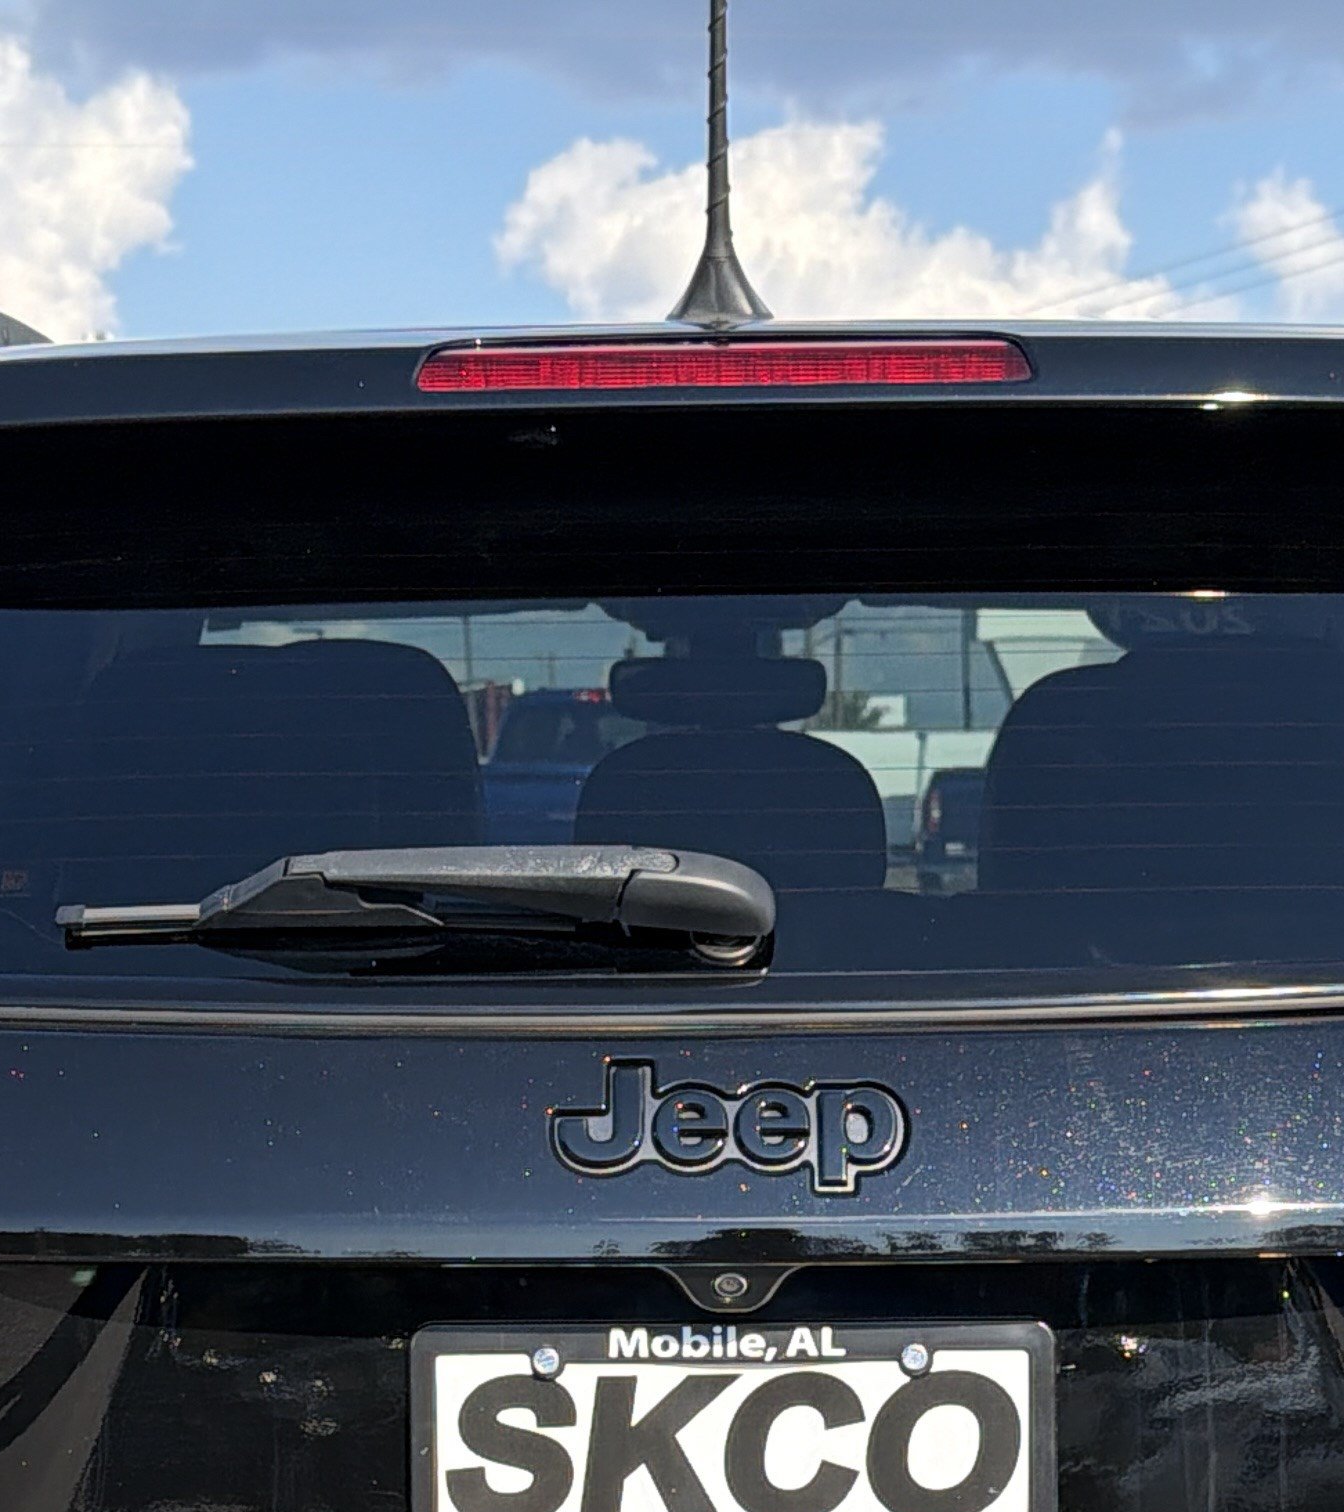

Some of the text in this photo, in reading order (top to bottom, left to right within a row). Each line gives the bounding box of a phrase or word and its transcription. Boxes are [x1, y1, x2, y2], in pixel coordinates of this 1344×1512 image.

[546, 1055, 913, 1197] Jeep
[608, 1327, 846, 1362] Mobile, AL
